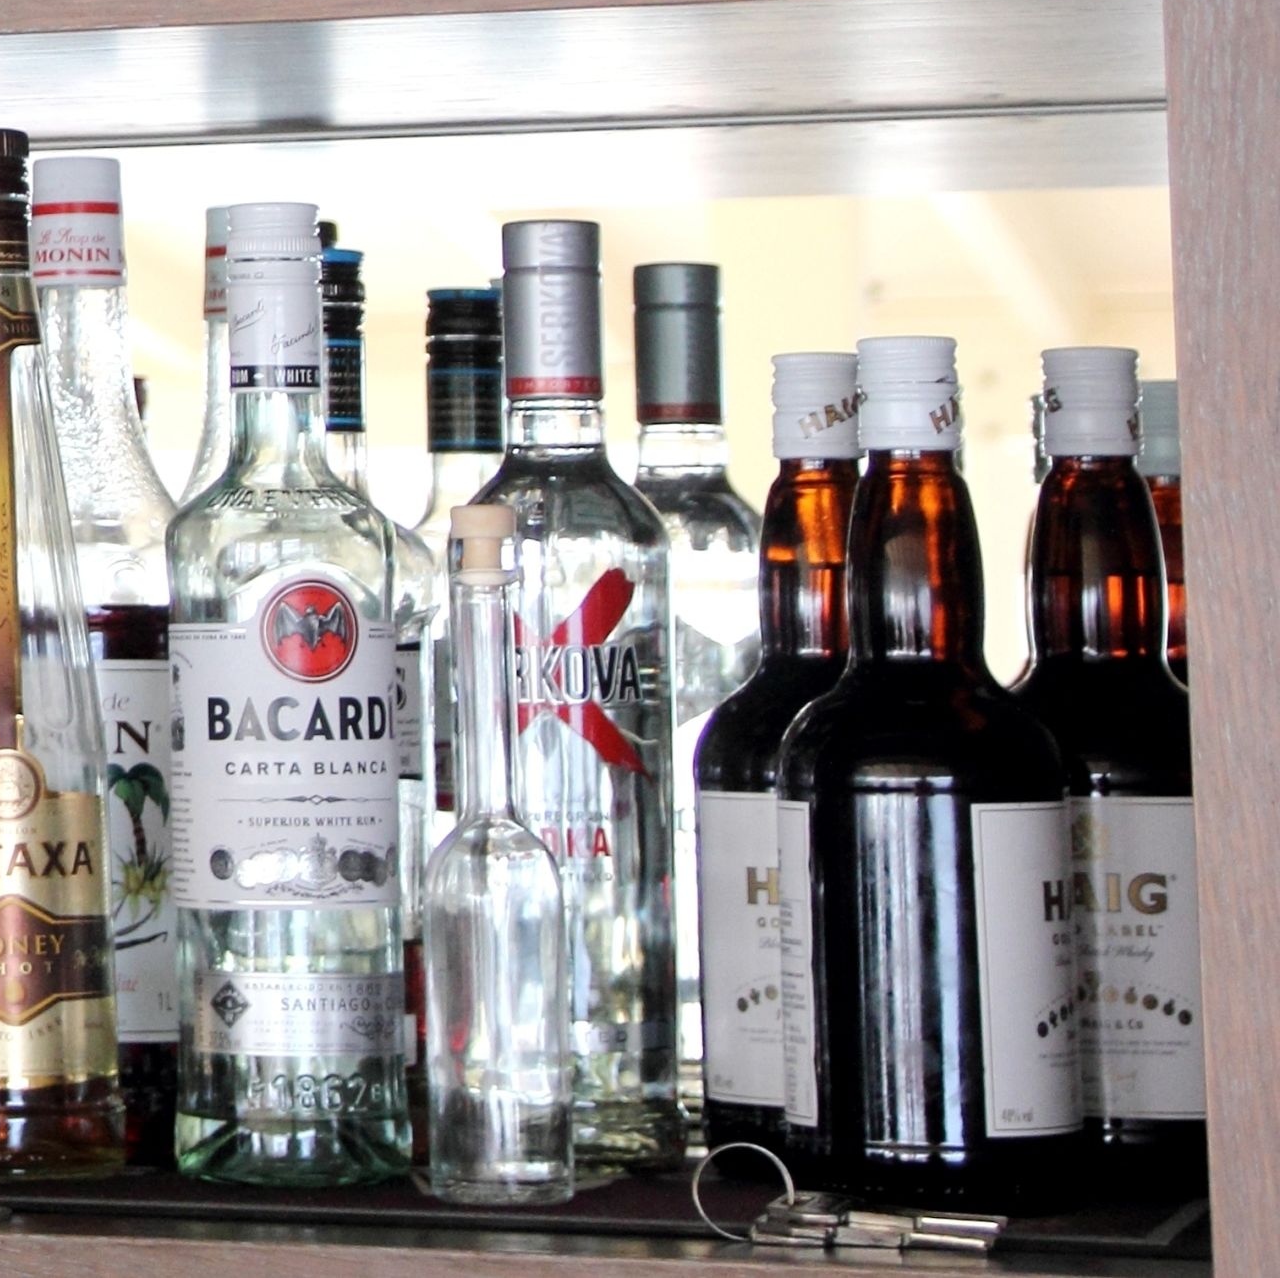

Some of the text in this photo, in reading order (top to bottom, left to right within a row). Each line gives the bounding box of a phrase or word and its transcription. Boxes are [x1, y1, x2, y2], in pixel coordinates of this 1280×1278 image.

[34, 247, 111, 264] MONIN
[4, 320, 32, 334] SHO
[276, 367, 314, 384] WHITE
[115, 720, 152, 754] N
[225, 759, 388, 776] CARTA BLANCA
[248, 815, 377, 827] SUPERIOR WHITE RUM
[280, 997, 371, 1013] SANTIAGO
[269, 1072, 369, 1113] 1862
